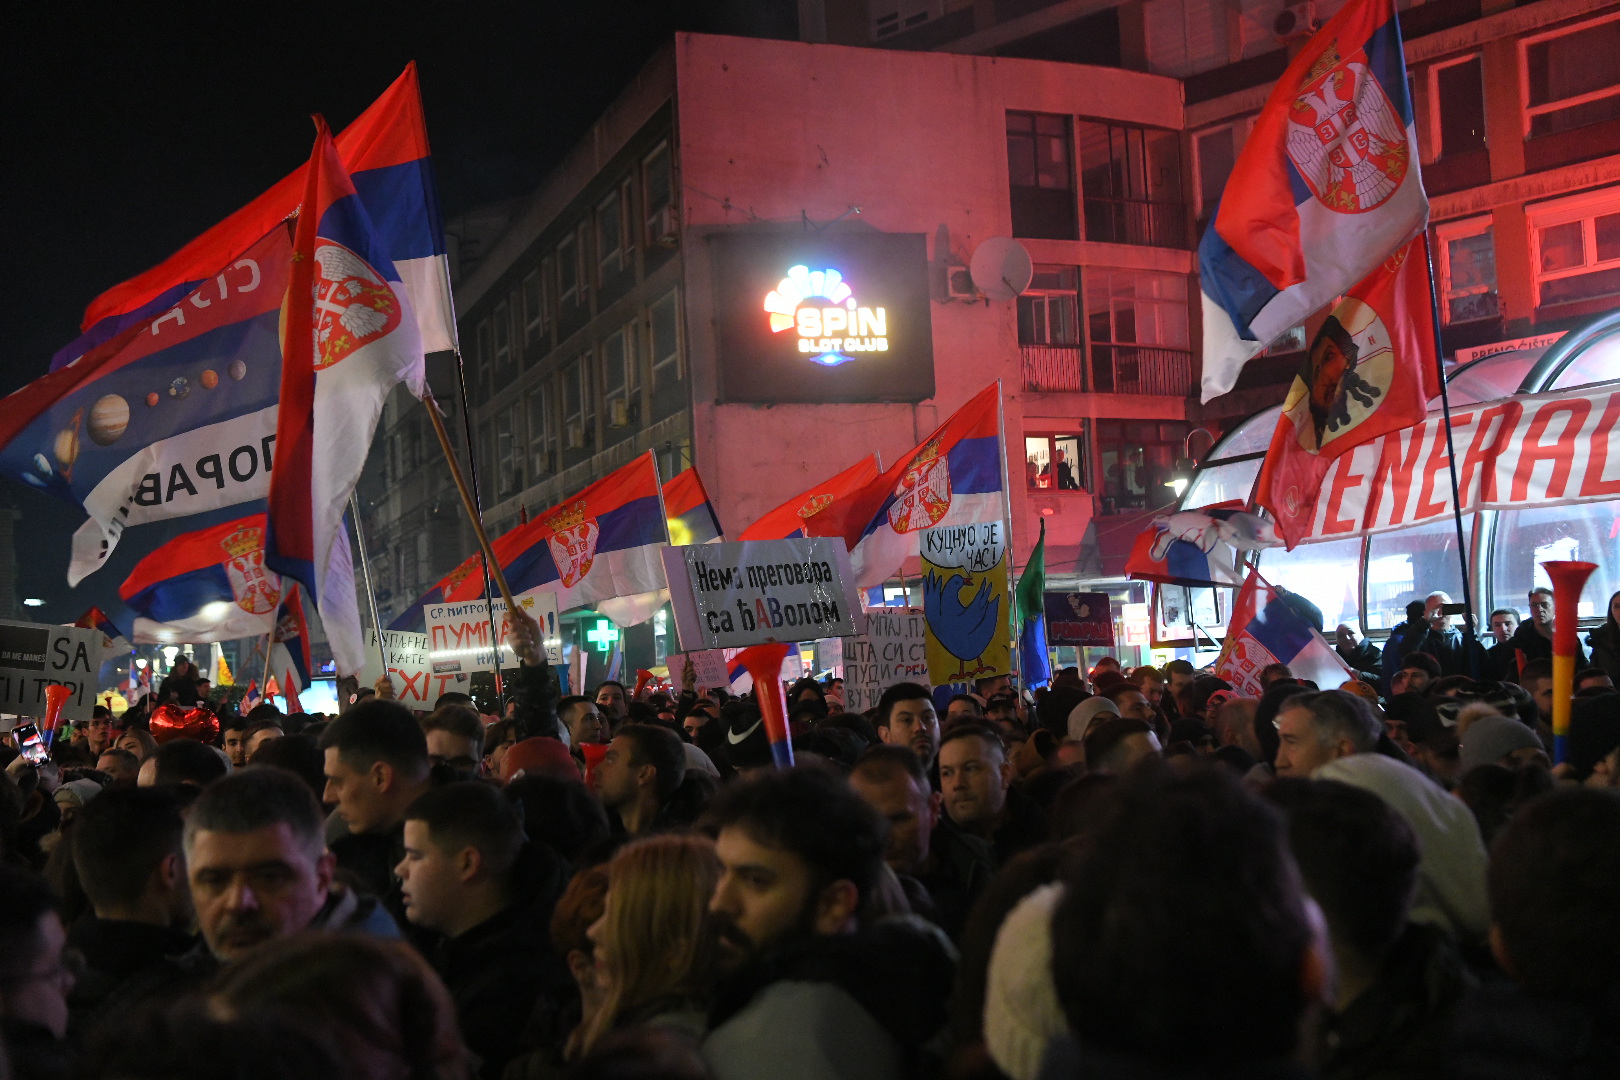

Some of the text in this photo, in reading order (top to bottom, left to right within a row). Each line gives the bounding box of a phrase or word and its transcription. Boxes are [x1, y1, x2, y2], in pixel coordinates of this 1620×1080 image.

[844, 338, 888, 351] CLUB
[1275, 392, 1620, 540] ENERAL
[926, 524, 999, 555] КУЦНУО ЈЕ
[967, 547, 996, 570] ЧАС!
[695, 560, 833, 595] Нема преговора
[706, 597, 841, 634] са ђАВолом
[12, 651, 23, 661] ME
[52, 637, 92, 673] SA
[390, 651, 425, 665] КАРТЕ
[843, 641, 878, 663] ШТА
[883, 642, 905, 663] СИ
[388, 667, 455, 701] XIT
